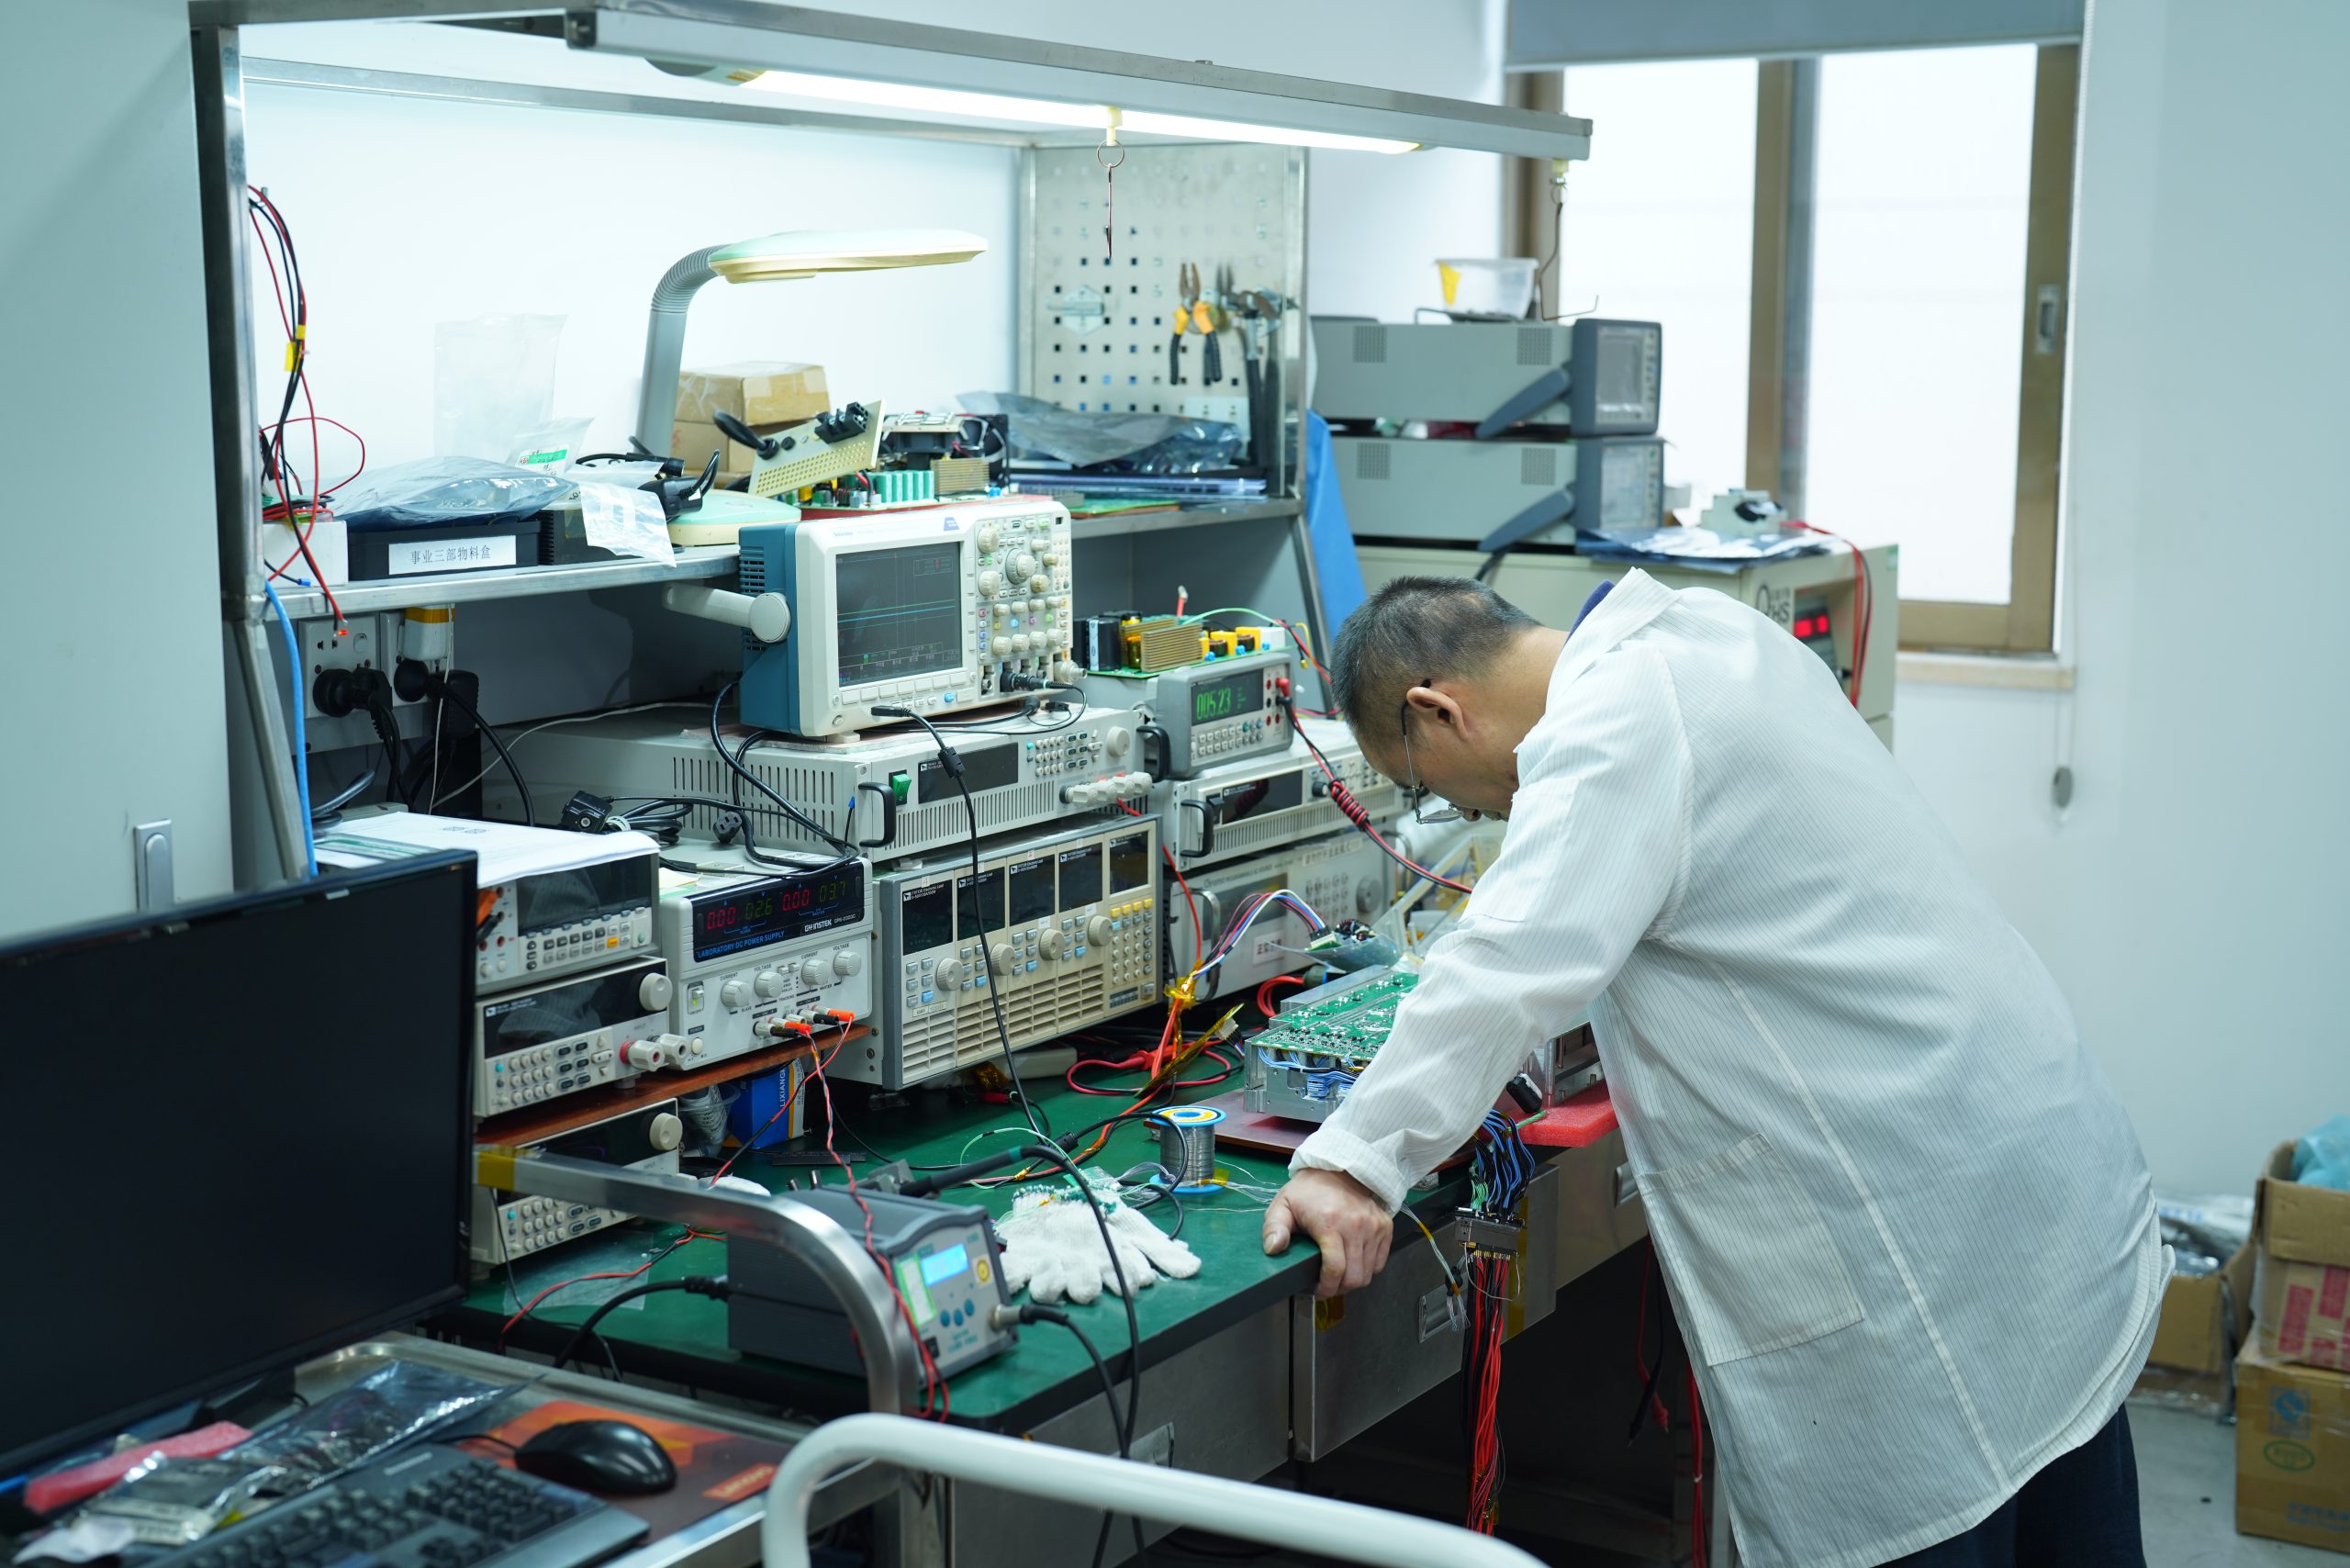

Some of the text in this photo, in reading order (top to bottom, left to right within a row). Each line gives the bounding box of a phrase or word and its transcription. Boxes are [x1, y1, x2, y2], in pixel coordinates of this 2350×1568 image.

[411, 544, 491, 565] 事业三部物料盒
[698, 931, 785, 958] LABORATORY DC POWER SUPPLY
[833, 943, 850, 951] VOLTAGE
[800, 951, 818, 960] CURRENT
[720, 972, 738, 981] CURRENT
